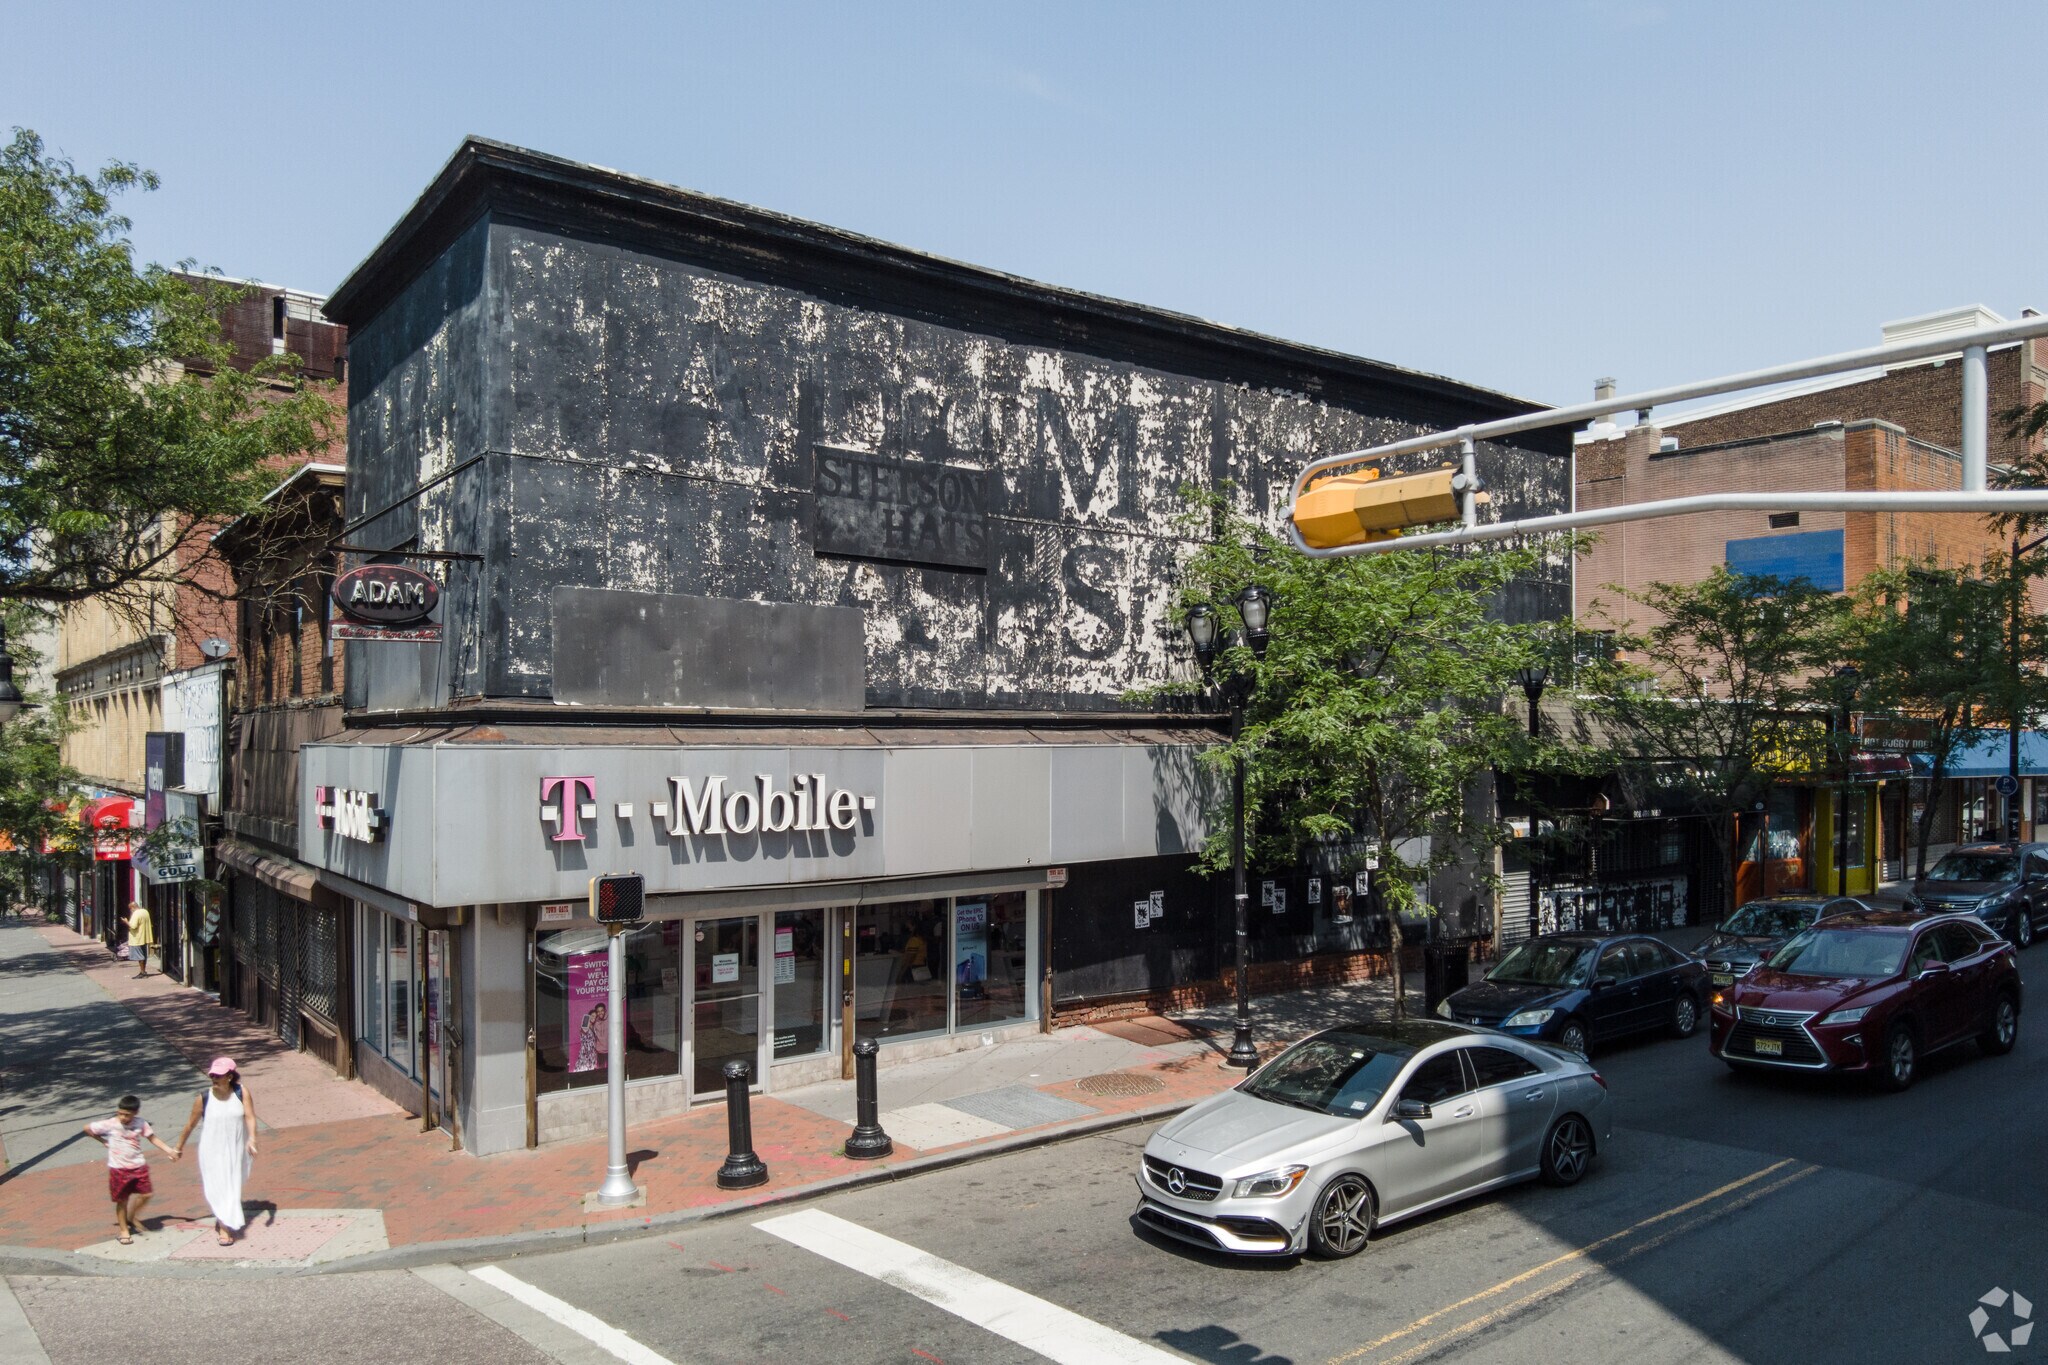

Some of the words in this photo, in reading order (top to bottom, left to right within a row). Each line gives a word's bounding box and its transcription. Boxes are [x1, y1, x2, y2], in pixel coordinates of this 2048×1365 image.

[816, 455, 988, 514] STETSON
[882, 508, 988, 559] HATS
[350, 580, 425, 605] ADAM
[158, 865, 197, 877] GOLD
[575, 986, 595, 995] YOUR
